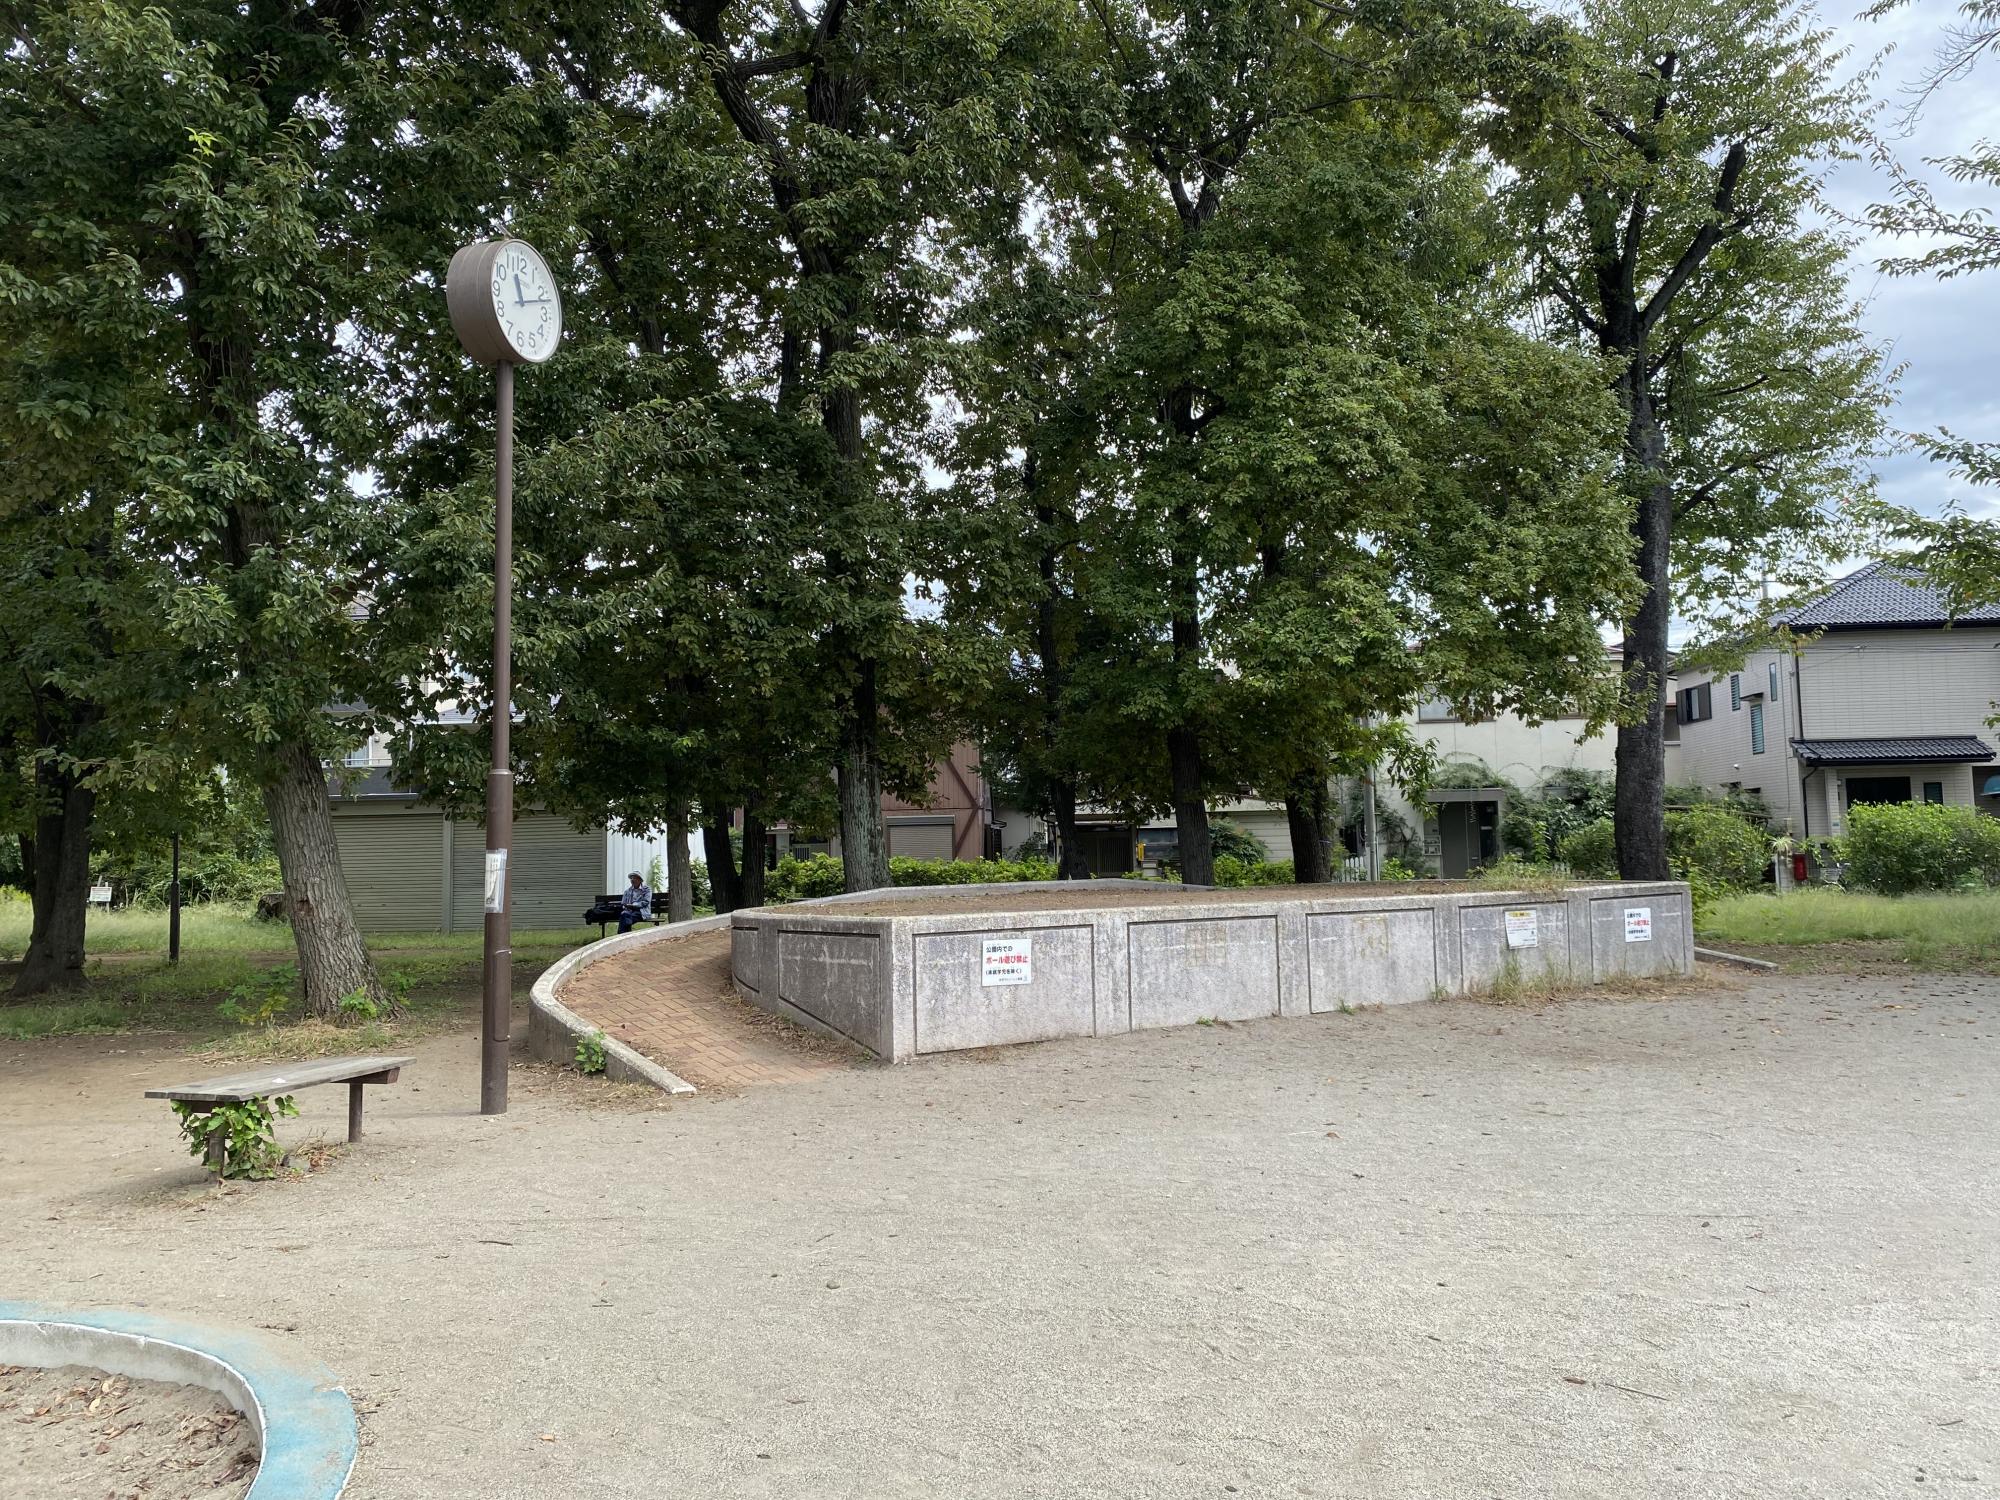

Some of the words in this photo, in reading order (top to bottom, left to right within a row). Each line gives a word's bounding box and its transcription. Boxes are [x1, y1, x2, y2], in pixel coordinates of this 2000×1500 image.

[496, 261, 507, 281] 10
[506, 253, 515, 272] 11
[517, 255, 527, 275] 12
[492, 280, 501, 297] 9
[537, 285, 545, 301] 2
[497, 301, 505, 318] 8
[540, 306, 548, 323] 3
[506, 320, 514, 336] 7
[537, 324, 544, 340] 4
[516, 331, 525, 348] 6
[528, 332, 536, 348] 5
[986, 954, 1028, 965] ボール遊び禁止
